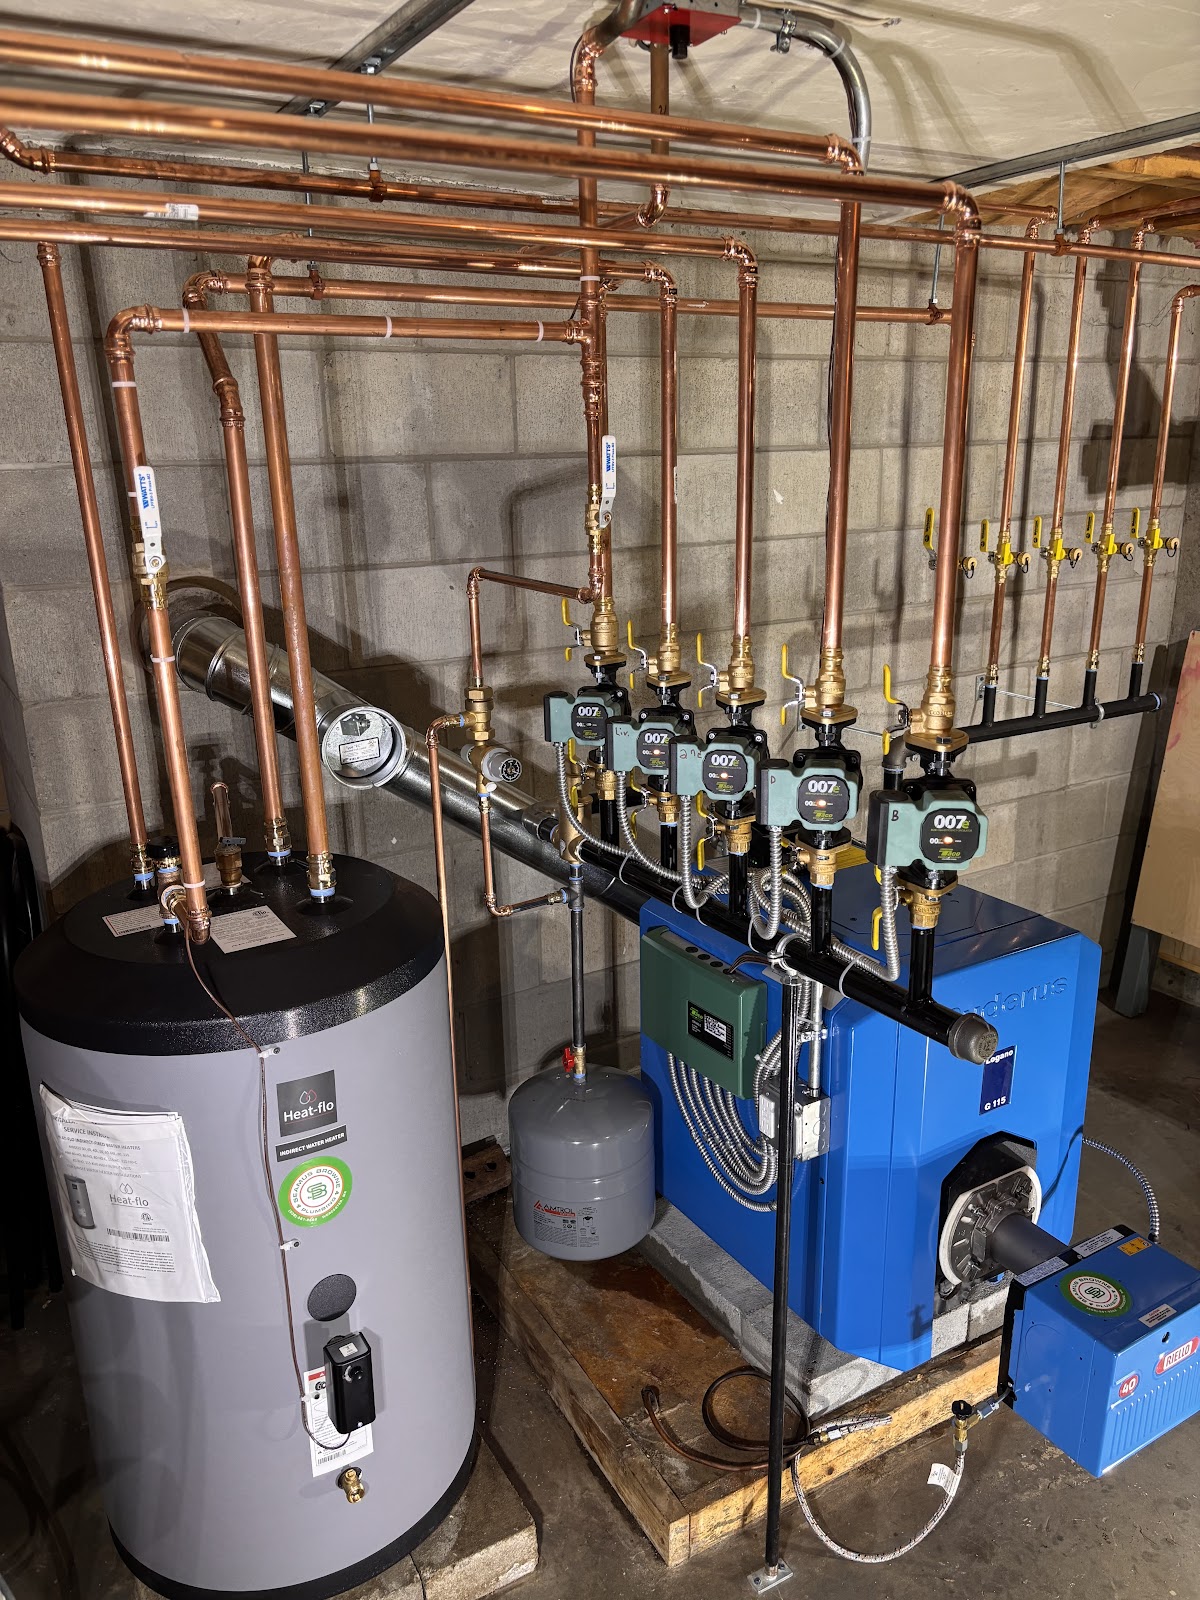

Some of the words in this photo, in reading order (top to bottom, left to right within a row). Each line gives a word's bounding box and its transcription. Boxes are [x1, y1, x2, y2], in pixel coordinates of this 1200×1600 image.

[139, 474, 149, 502] WATTS
[891, 809, 899, 821] B
[985, 1049, 1014, 1065] Logano
[283, 1100, 334, 1122] Heat-flo
[984, 1103, 991, 1111] G
[992, 1096, 1007, 1108] 115
[64, 1126, 86, 1135] SERVICE
[279, 1145, 306, 1157] INDIRECT
[306, 1139, 325, 1149] WATER
[325, 1132, 345, 1143] HEATER
[292, 1171, 313, 1204] SEAMUS
[316, 1168, 341, 1189] BROWNE
[109, 1194, 149, 1207] Heat-flo
[544, 1204, 575, 1214] AMTROL
[1079, 1277, 1113, 1290] BROWNE
[1166, 1344, 1190, 1367] RIELLO
[1122, 1378, 1136, 1394] 40
